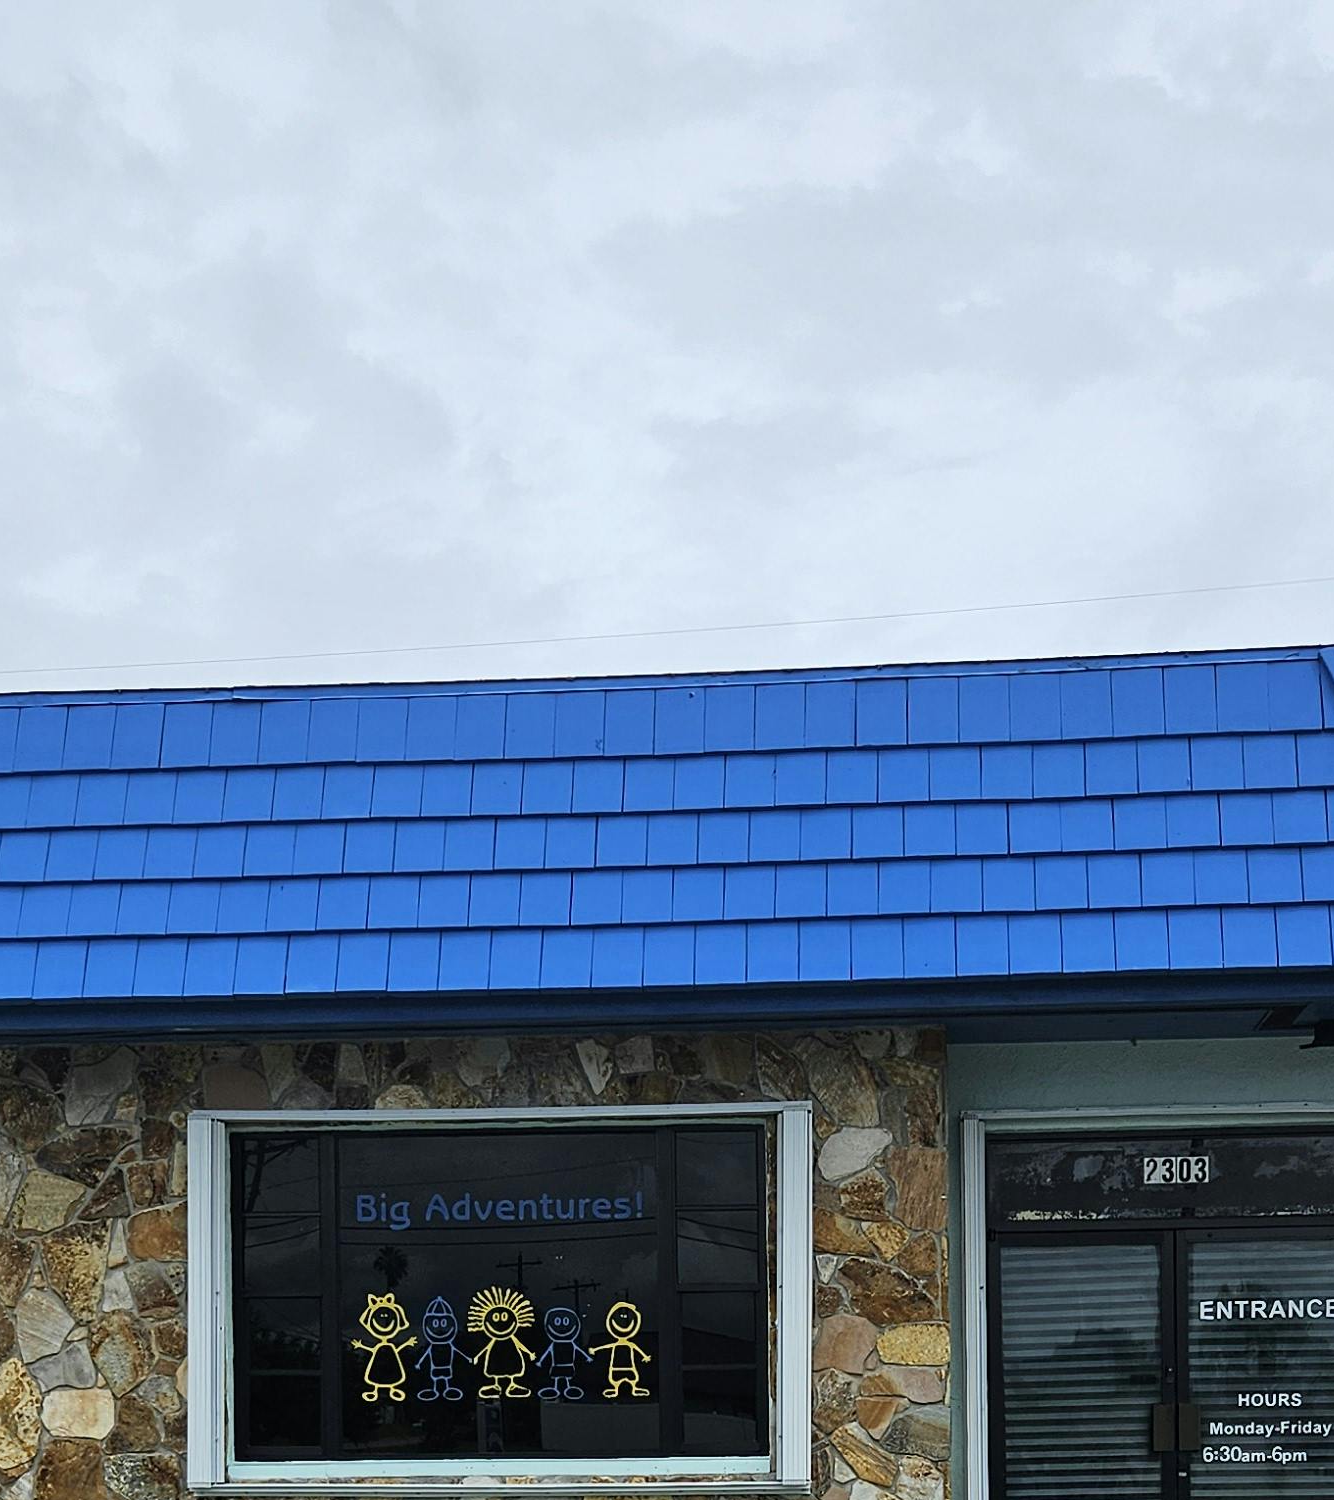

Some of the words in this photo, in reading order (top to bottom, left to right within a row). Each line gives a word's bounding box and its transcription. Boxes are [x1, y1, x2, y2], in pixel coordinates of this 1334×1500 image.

[1146, 1158, 1207, 1183] 2303
[356, 1193, 411, 1231] Big
[424, 1191, 644, 1222] Adventures!
[1237, 1392, 1303, 1408] HOURS
[1209, 1420, 1333, 1438] Monday-Friday
[1202, 1446, 1308, 1464] 6:30am-6pm
